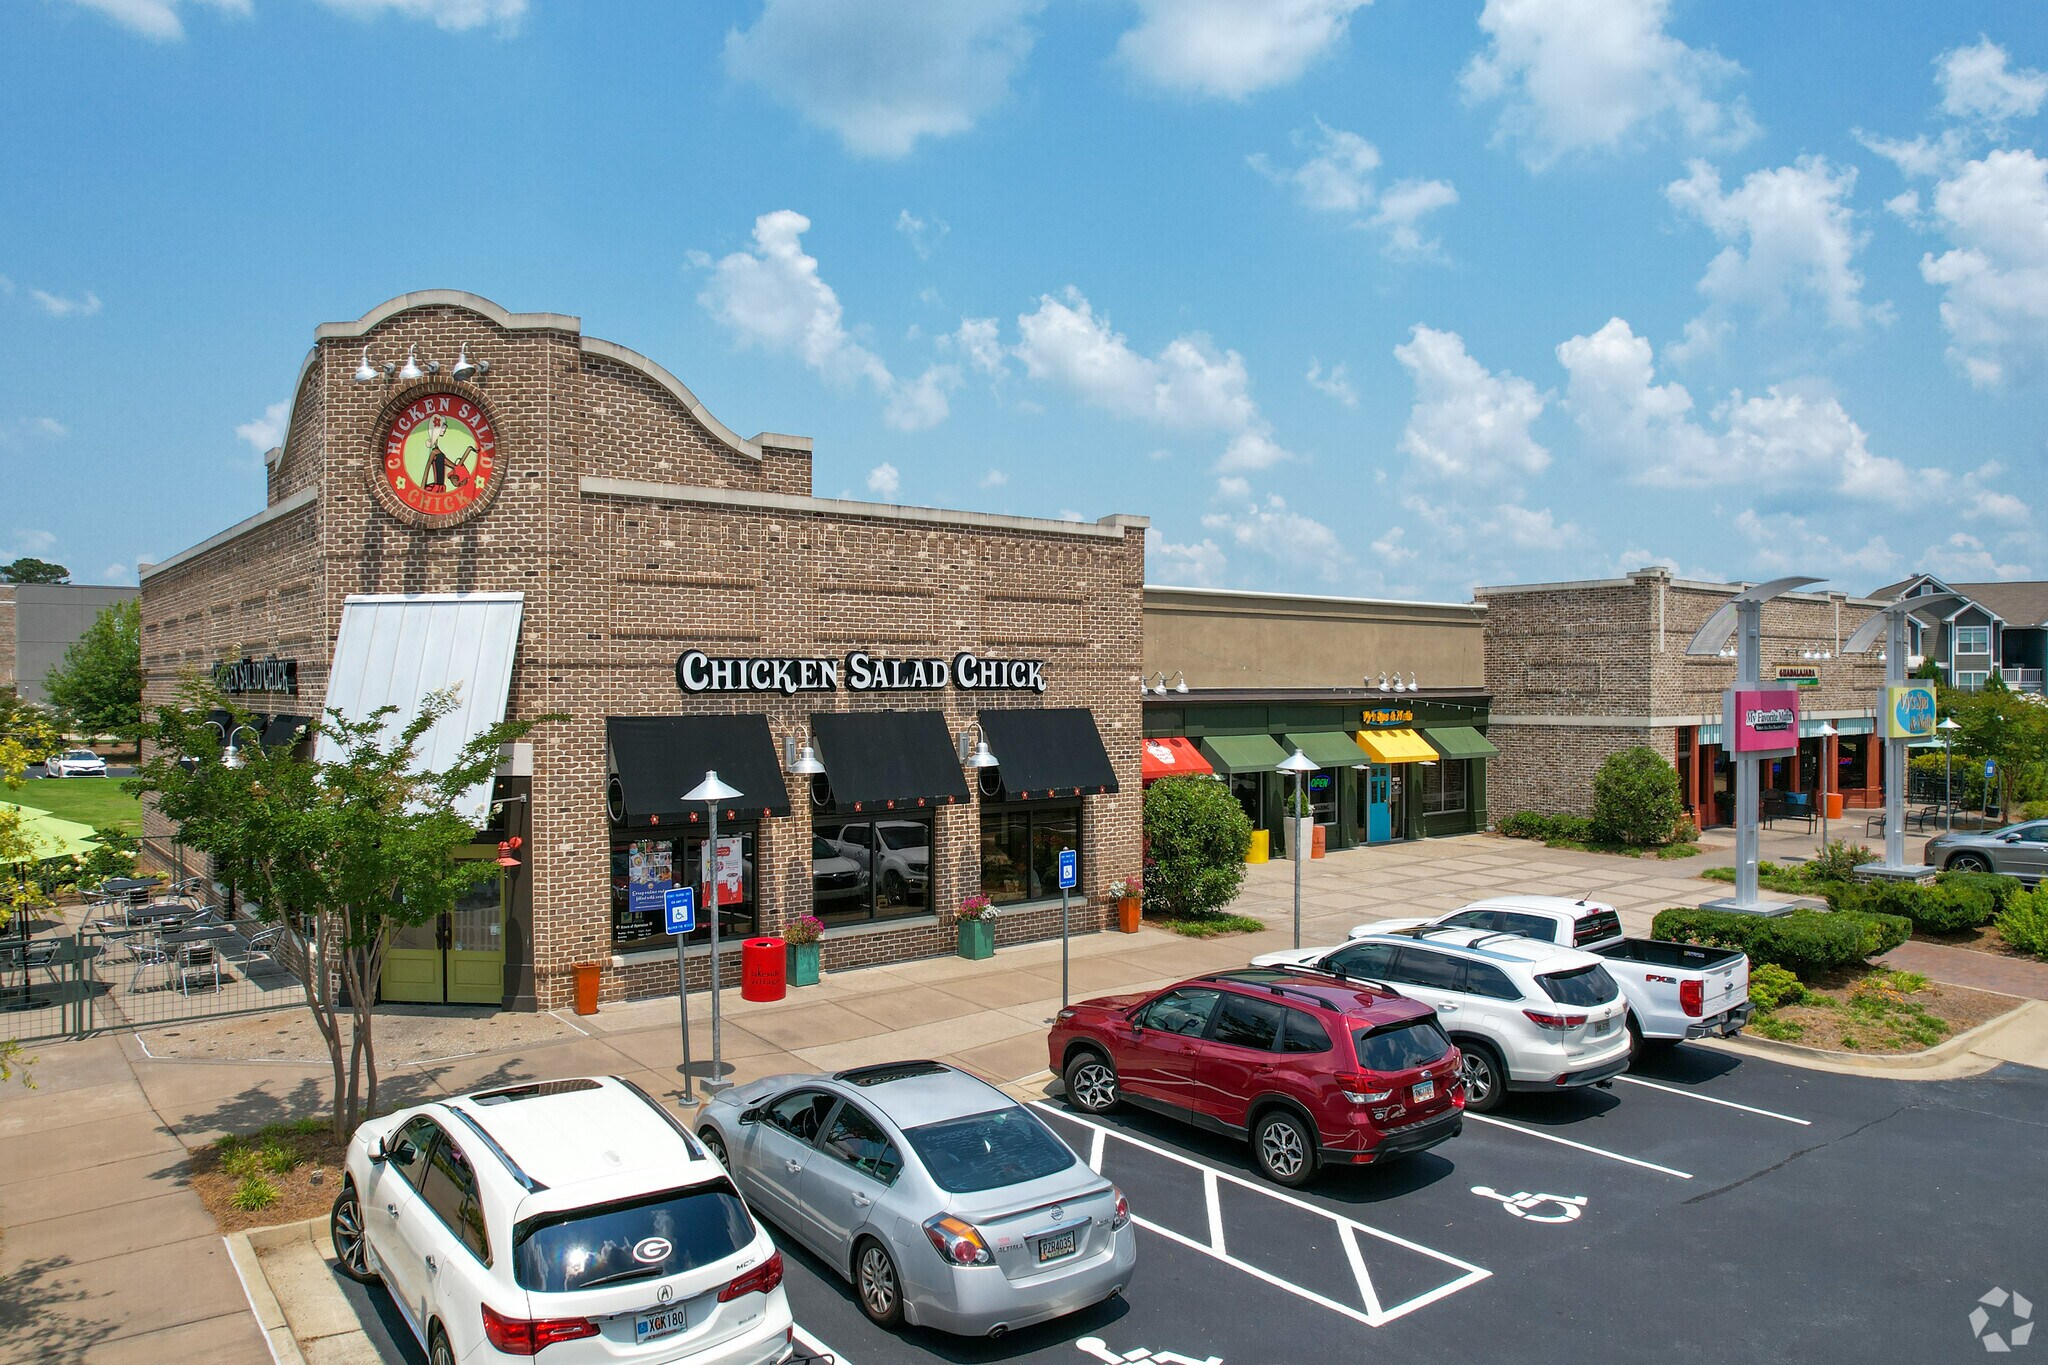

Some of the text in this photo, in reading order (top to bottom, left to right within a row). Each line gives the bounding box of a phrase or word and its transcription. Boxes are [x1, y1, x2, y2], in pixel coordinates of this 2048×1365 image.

[387, 398, 494, 470] CHICKEN SALAD
[407, 489, 472, 512] CHICK
[264, 656, 289, 694] CHICK
[679, 650, 1047, 695] CHICKEN SALAD CHICK
[1779, 668, 1815, 677] GUADALAJARA
[1747, 711, 1756, 724] My
[1757, 711, 1778, 722] Favorite
[1311, 778, 1328, 788] OPEN
[635, 1238, 671, 1261] G
[997, 1243, 1023, 1254] ALTIMA
[1043, 1236, 1072, 1254] PZR4035
[649, 1311, 684, 1333] XGK180
